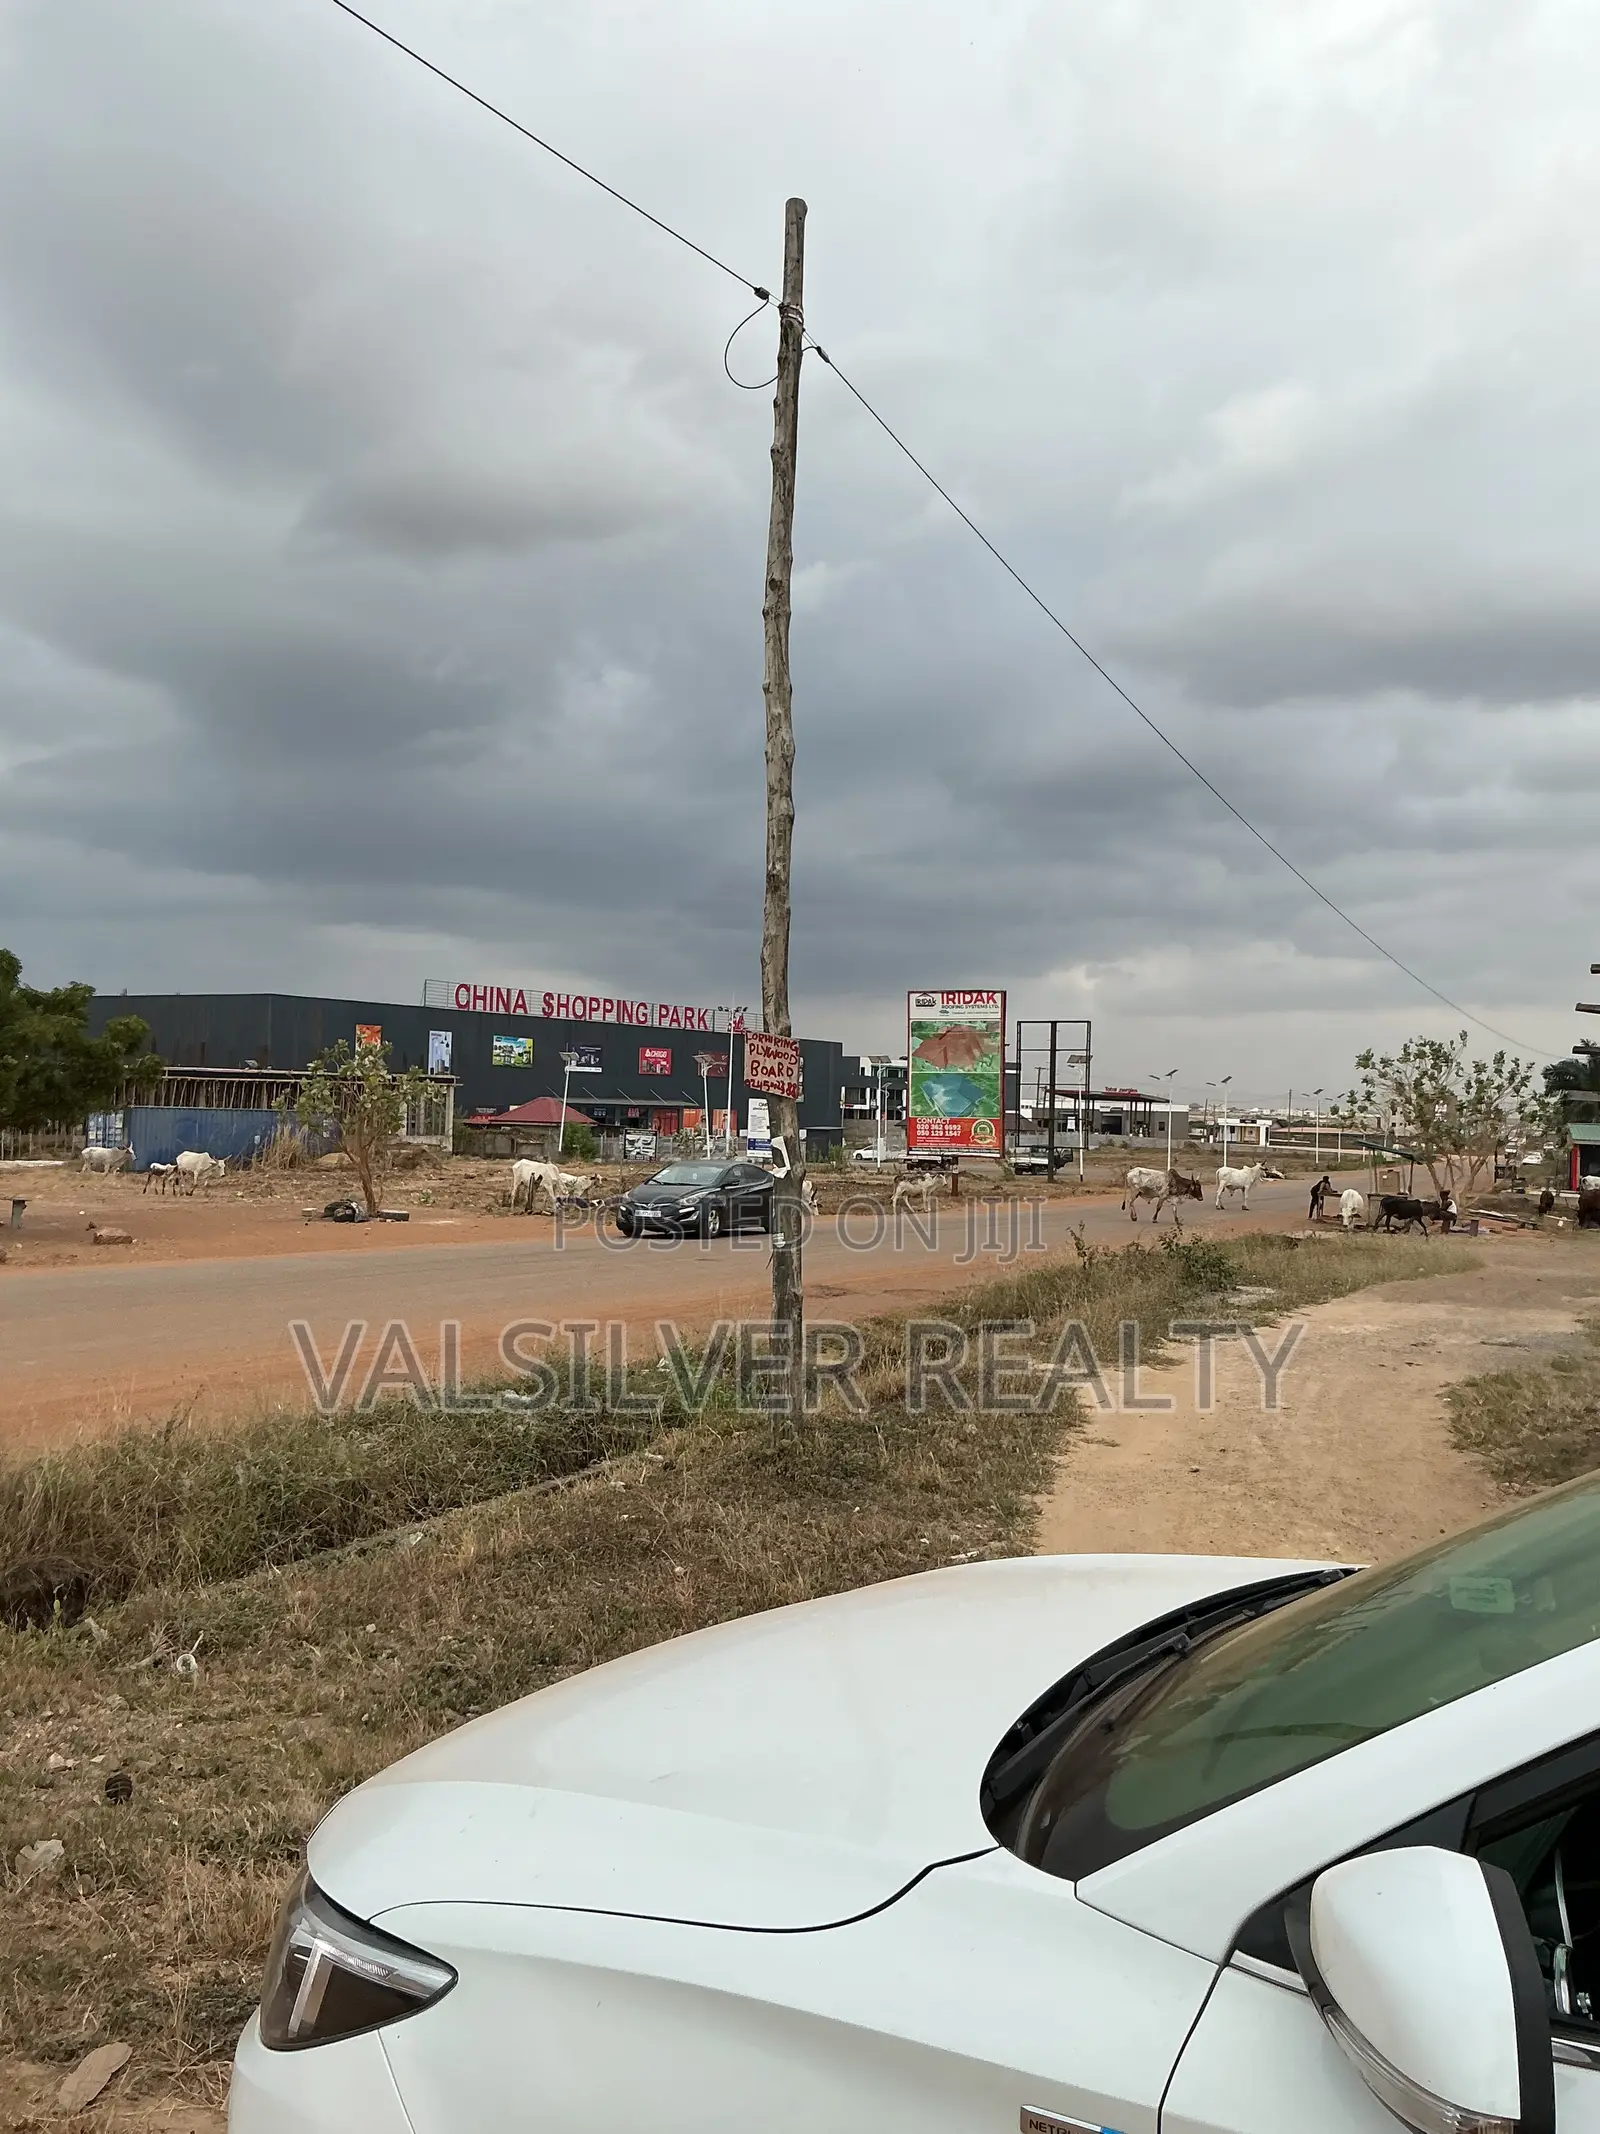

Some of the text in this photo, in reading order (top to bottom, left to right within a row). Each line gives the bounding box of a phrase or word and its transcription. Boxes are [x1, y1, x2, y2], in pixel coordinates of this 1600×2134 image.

[454, 984, 709, 1030] CHINA SHOPPING PARK
[941, 992, 997, 1005] IRIDAK
[749, 1043, 797, 1065] PLYWOOD
[751, 1060, 794, 1078] BOARD
